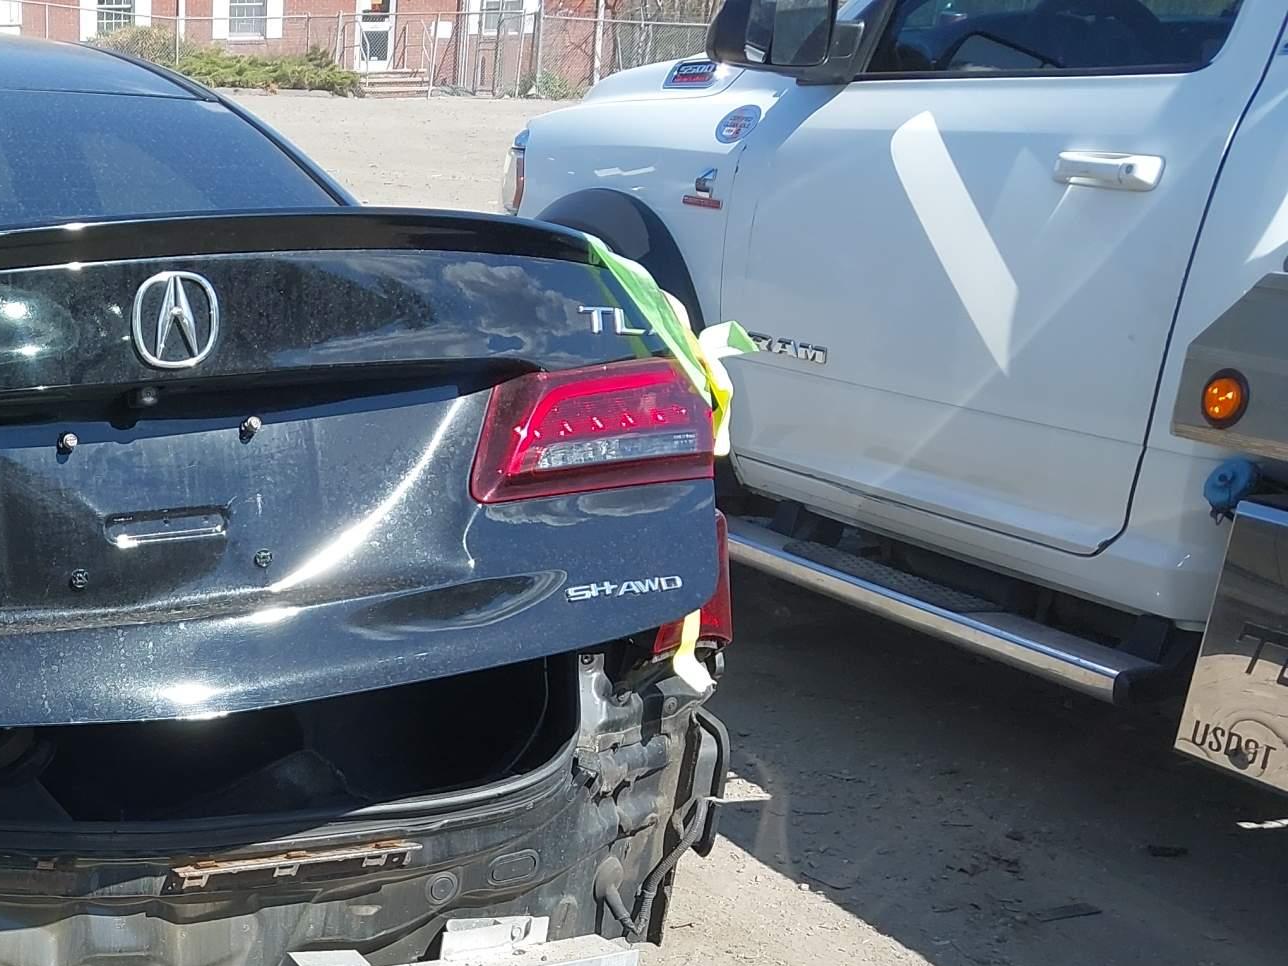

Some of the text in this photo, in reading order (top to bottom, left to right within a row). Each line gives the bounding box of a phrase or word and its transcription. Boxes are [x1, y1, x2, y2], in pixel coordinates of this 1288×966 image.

[578, 305, 656, 337] TL
[748, 330, 829, 365] RAM
[1191, 719, 1277, 770] USDOT
